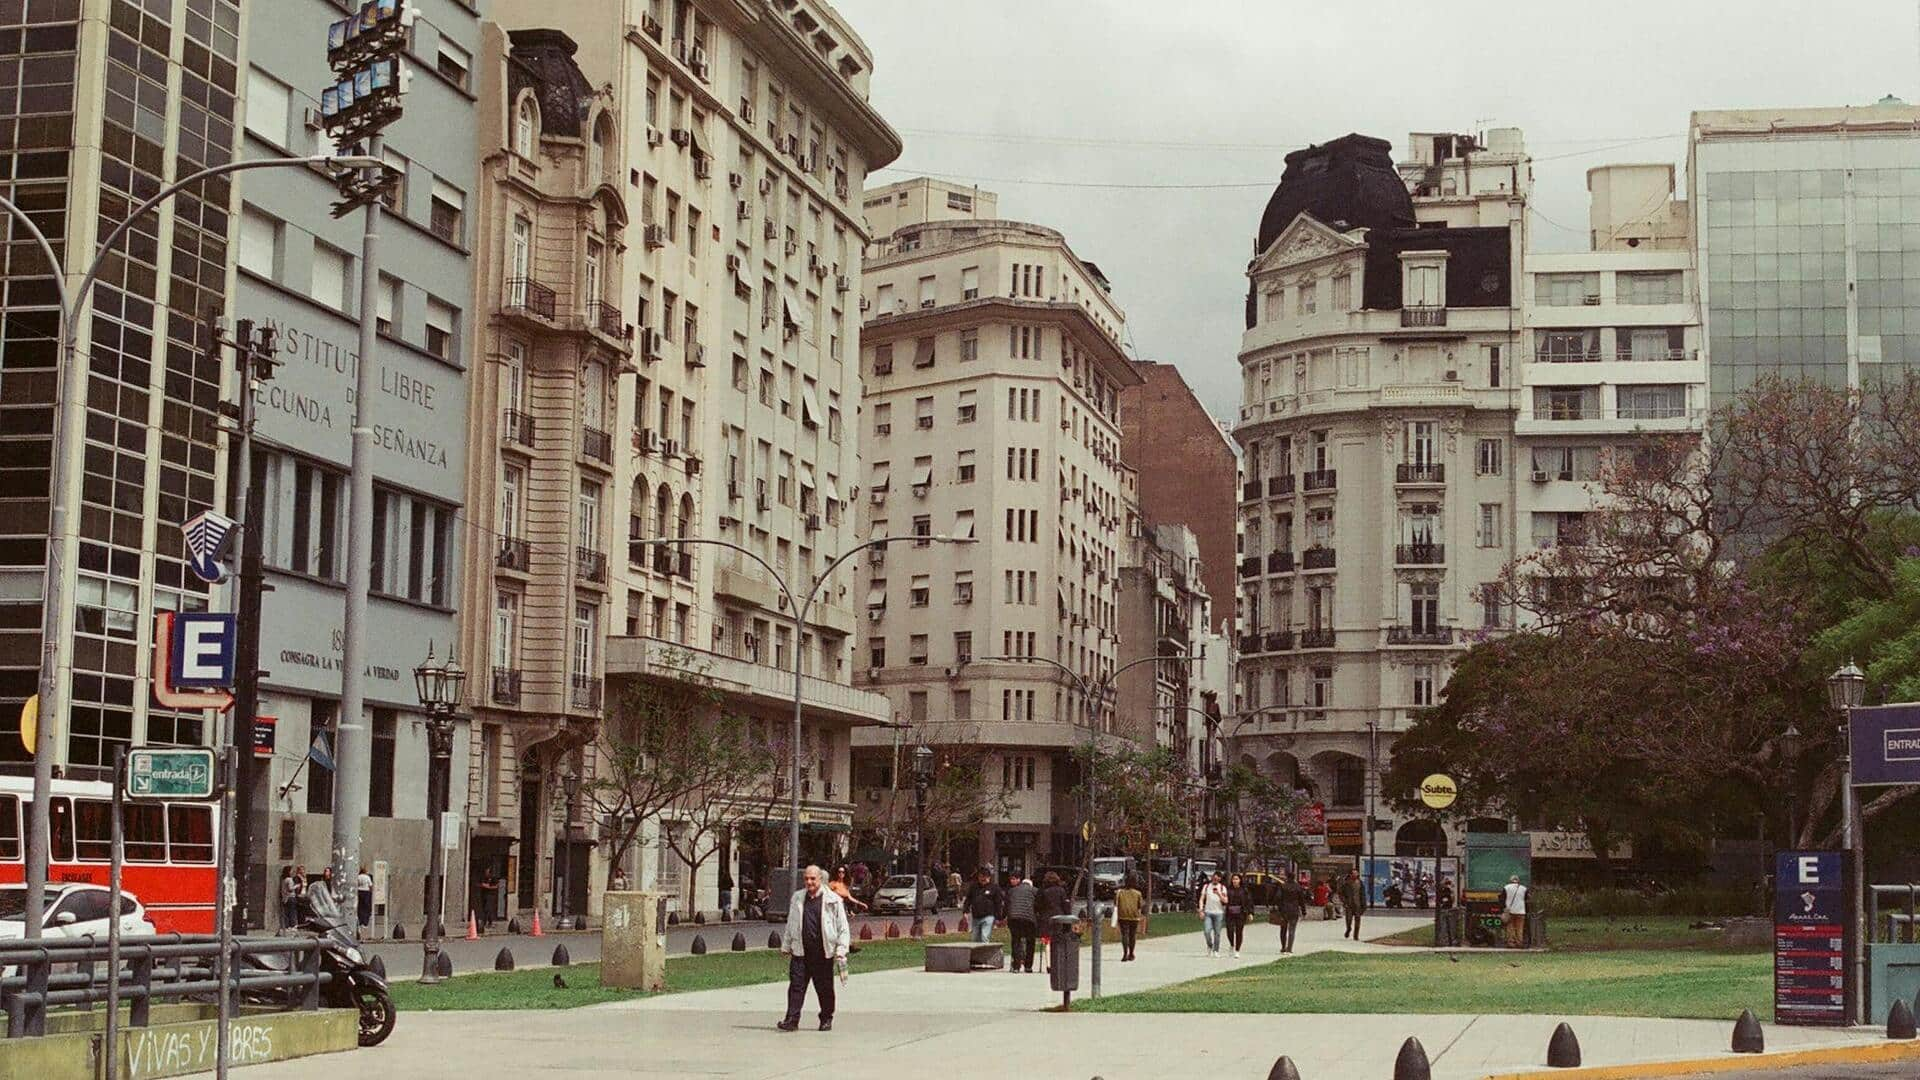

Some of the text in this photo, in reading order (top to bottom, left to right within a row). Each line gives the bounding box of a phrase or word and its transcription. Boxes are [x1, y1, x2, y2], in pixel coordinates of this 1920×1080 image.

[266, 317, 436, 411] INSTITUT LIBRE
[255, 383, 331, 429] EGUNDA
[182, 621, 224, 679] E
[152, 769, 190, 780] entrada
[1423, 784, 1453, 794] Subte
[1799, 857, 1819, 883] E
[199, 1025, 212, 1062] Y
